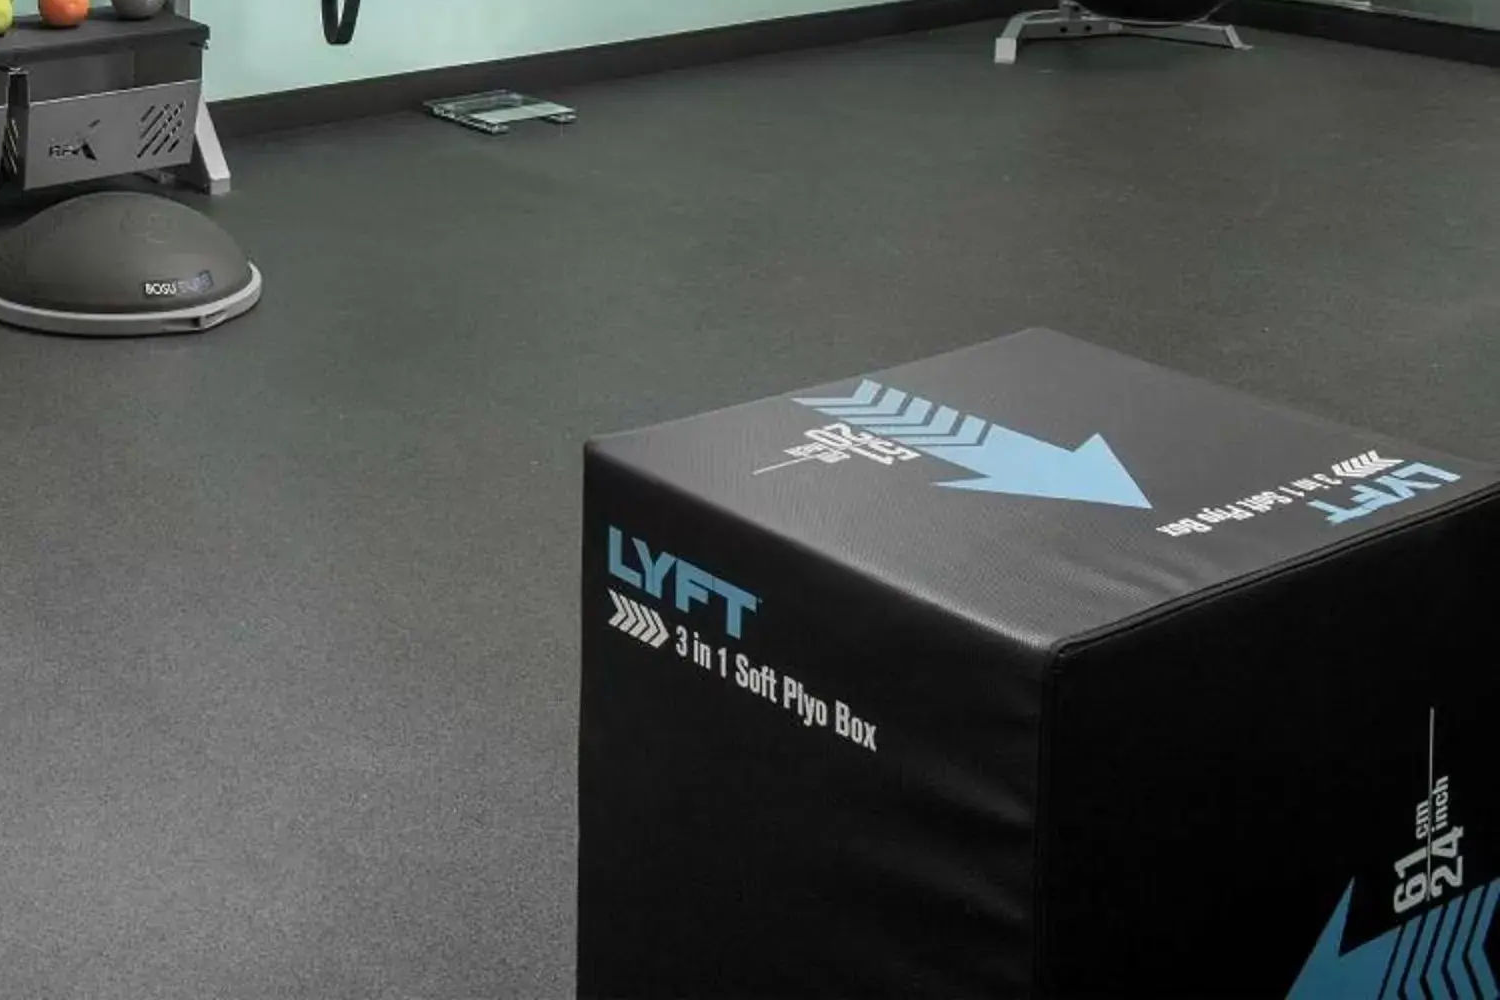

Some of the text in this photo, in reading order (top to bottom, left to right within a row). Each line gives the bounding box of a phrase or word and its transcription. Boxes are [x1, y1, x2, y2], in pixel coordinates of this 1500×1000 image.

[145, 281, 176, 295] BOSU
[1307, 461, 1461, 525] LYFT
[608, 524, 758, 640] LYFT
[675, 624, 878, 753] 3 in 1 Soft Plyo Box
[1393, 800, 1429, 914] 61 cm
[1431, 775, 1464, 899] 24 inch
